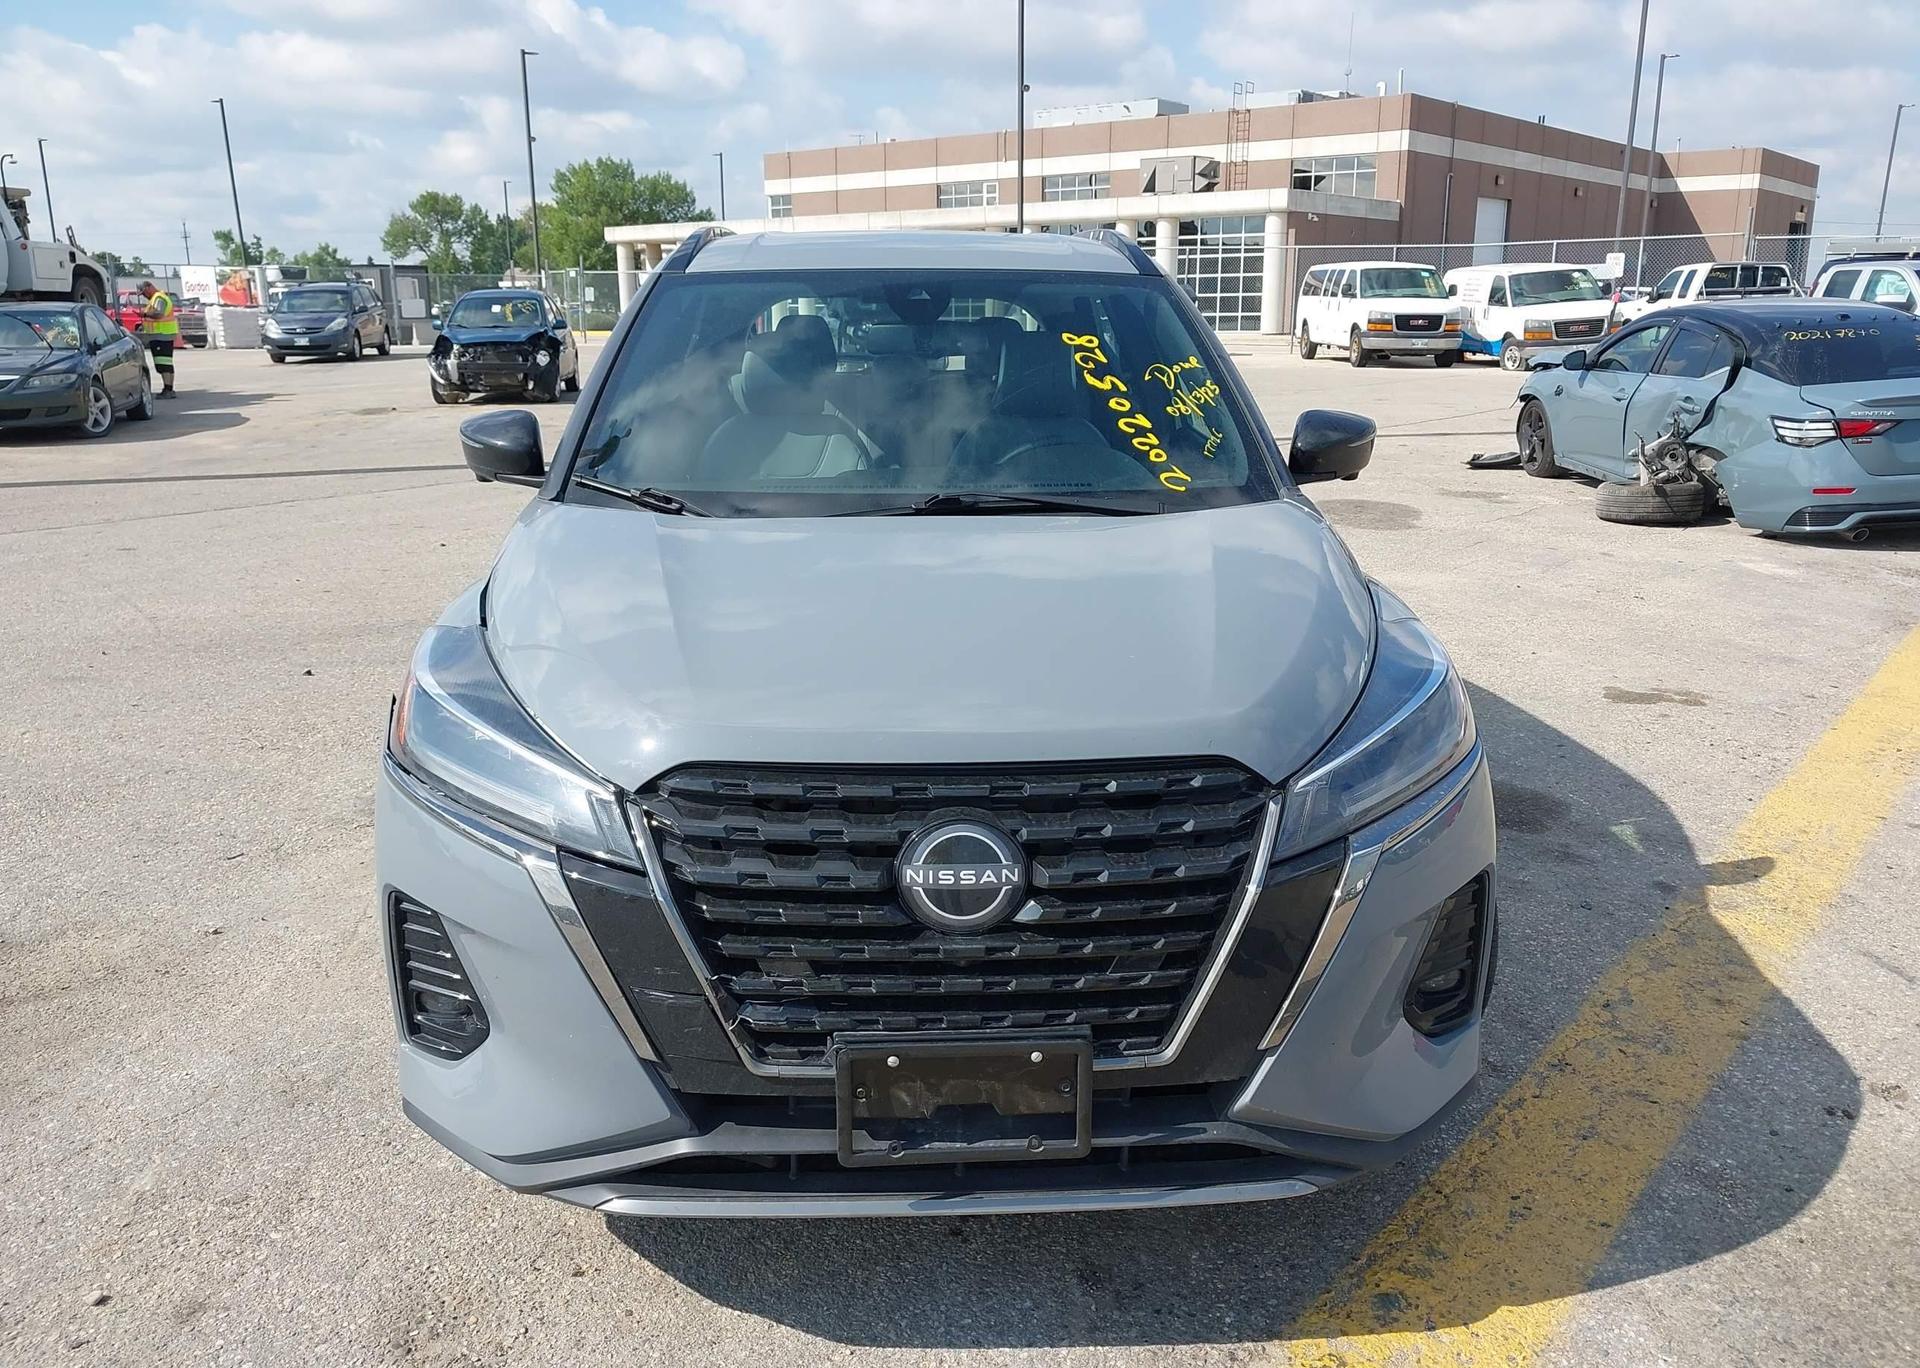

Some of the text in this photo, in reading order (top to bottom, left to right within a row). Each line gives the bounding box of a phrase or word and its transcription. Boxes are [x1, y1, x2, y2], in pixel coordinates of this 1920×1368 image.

[1144, 355, 1205, 390] Done
[1061, 332, 1192, 493] 20220528
[1165, 380, 1221, 418] 08/13/25
[906, 867, 1019, 885] NISSAN
